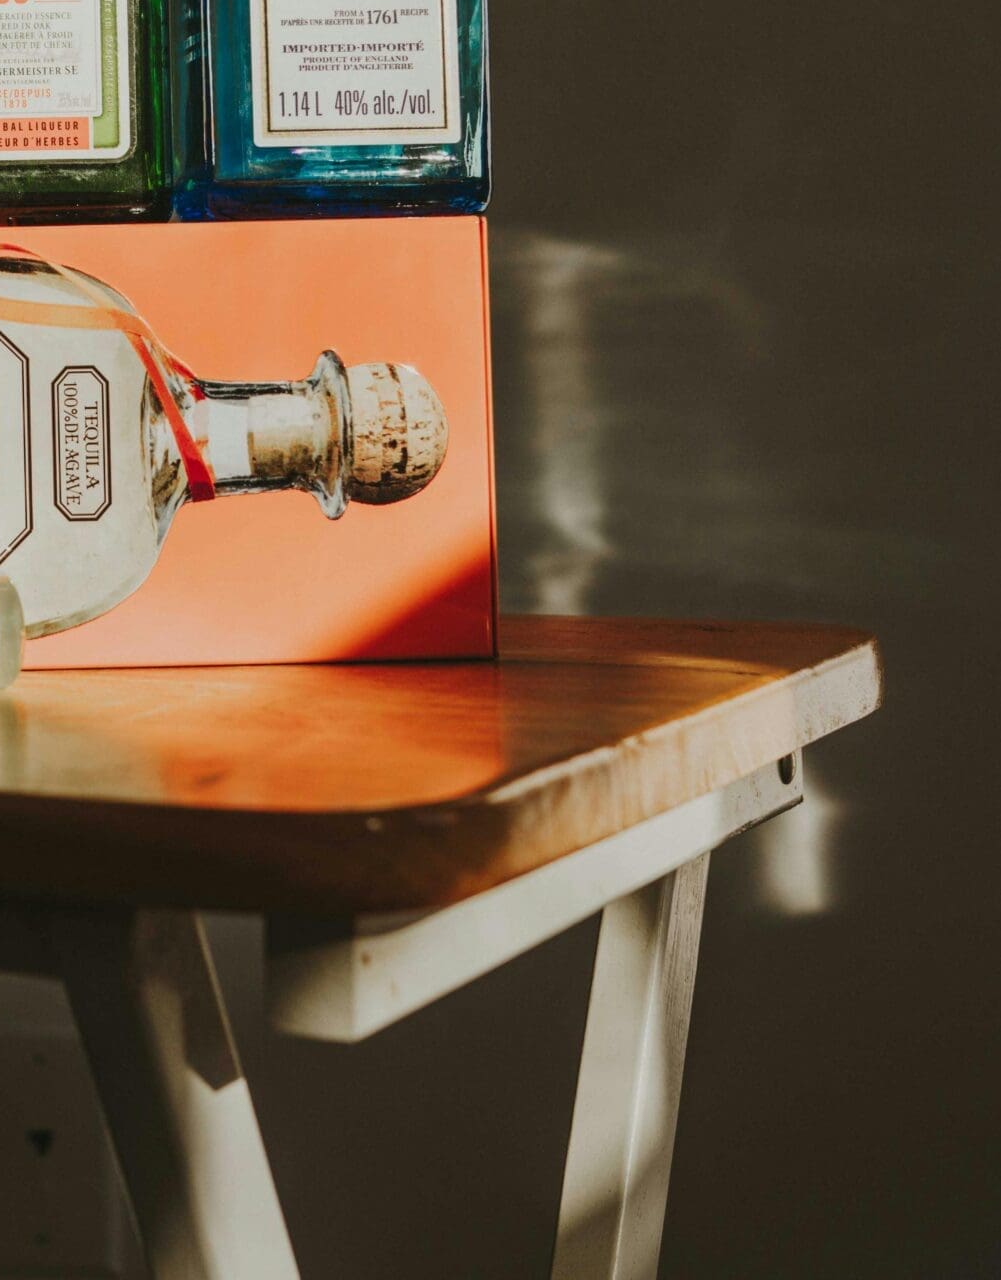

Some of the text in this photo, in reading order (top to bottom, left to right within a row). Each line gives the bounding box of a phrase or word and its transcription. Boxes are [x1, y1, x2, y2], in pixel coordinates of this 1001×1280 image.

[366, 9, 399, 25] 1761
[400, 8, 429, 17] RECIPE
[21, 22, 31, 30] IN
[33, 22, 51, 30] OAK
[30, 41, 41, 49] DE
[64, 65, 78, 75] SE
[298, 63, 340, 71] PRODUIT
[3, 100, 28, 109] 1878
[279, 89, 436, 117] 1.14 L 40% alc./vol.
[28, 121, 79, 131] LIQUEUR
[23, 136, 79, 147] D'HERBES
[83, 400, 101, 490] TEQUILA
[65, 447, 81, 505] AGAVE
